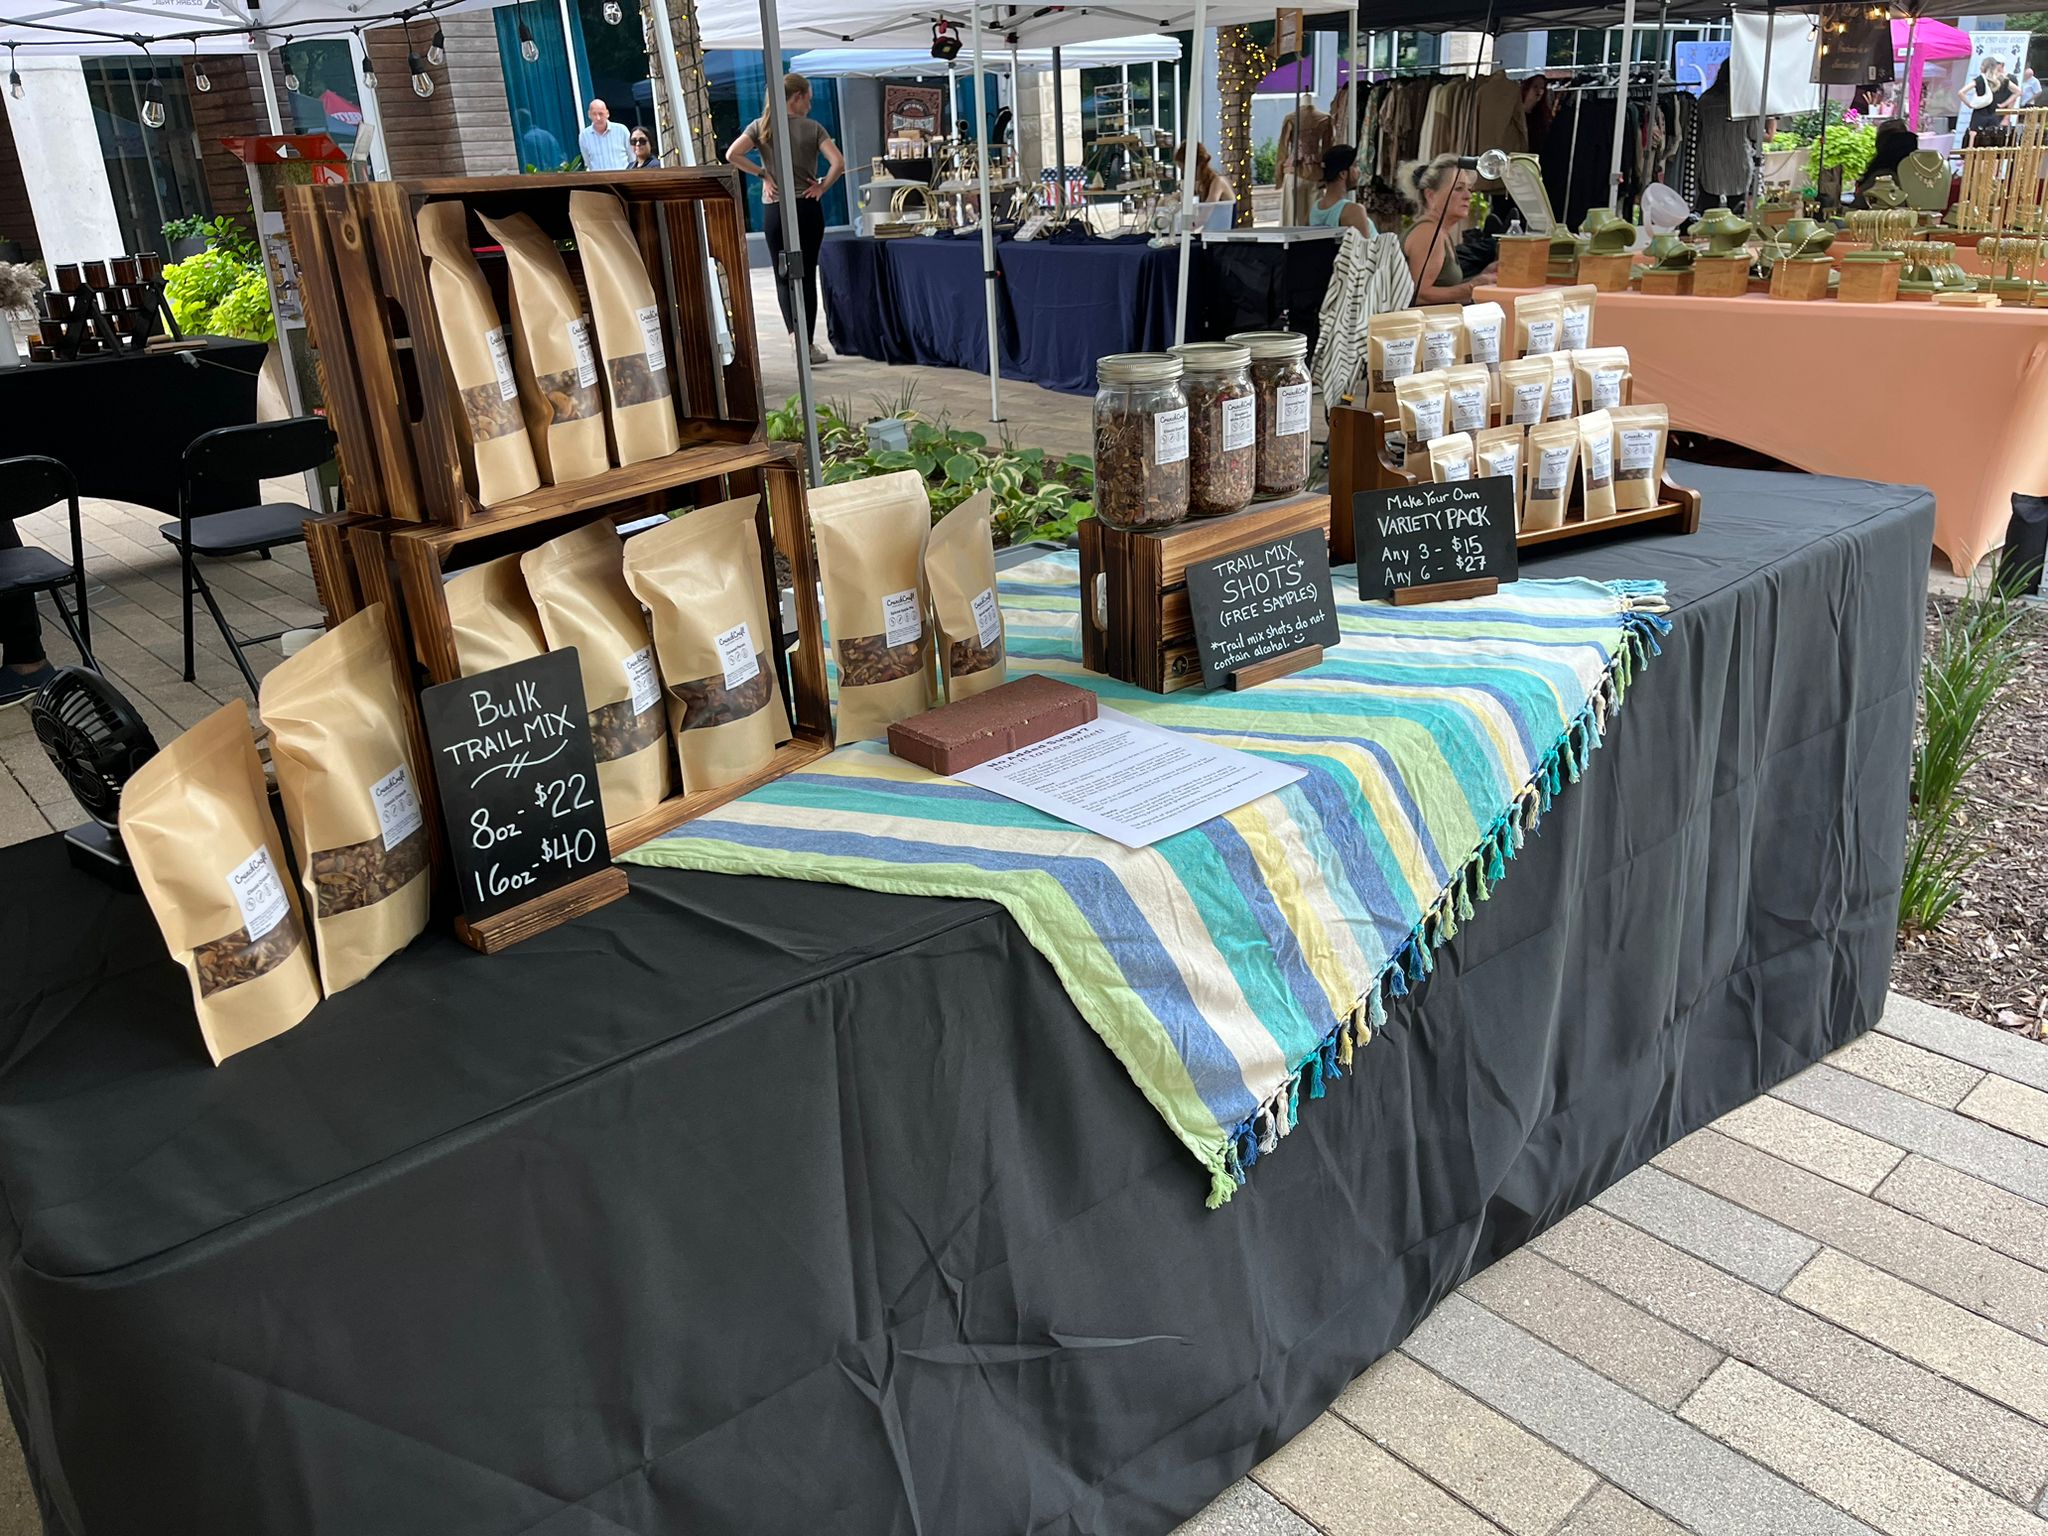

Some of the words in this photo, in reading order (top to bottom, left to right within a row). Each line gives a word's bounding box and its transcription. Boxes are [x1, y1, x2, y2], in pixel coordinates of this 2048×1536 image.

[1386, 494, 1424, 511] Make
[1423, 490, 1450, 507] Your
[1452, 487, 1480, 501] Own
[1377, 510, 1443, 538] VARIETY
[1445, 505, 1491, 530] PACK
[1212, 554, 1263, 577] TRAIL
[1265, 540, 1298, 565] MIX
[1381, 546, 1409, 565] Any
[1418, 543, 1430, 560] 3
[1451, 535, 1483, 555] $15
[1384, 567, 1411, 587] Any
[1420, 565, 1431, 580] 6
[1455, 555, 1487, 573] $27
[1219, 603, 1259, 628] (FREE
[1262, 582, 1317, 613] SAMPLES)
[1247, 631, 1265, 646] mix
[1265, 620, 1293, 639] shots
[1295, 615, 1309, 630] do
[1309, 609, 1326, 625] not
[1213, 651, 1251, 671] contain
[1254, 637, 1290, 657] alcohol.
[470, 680, 542, 727] Bulk
[443, 729, 523, 765] TRAIL
[524, 704, 576, 743] MIX
[987, 760, 1006, 768] No
[1007, 744, 1047, 761] Added
[1046, 727, 1089, 746] Sugar?
[1029, 743, 1068, 758] tastes
[470, 808, 522, 849] 8oz
[534, 774, 594, 818] $22
[541, 828, 596, 869] $40
